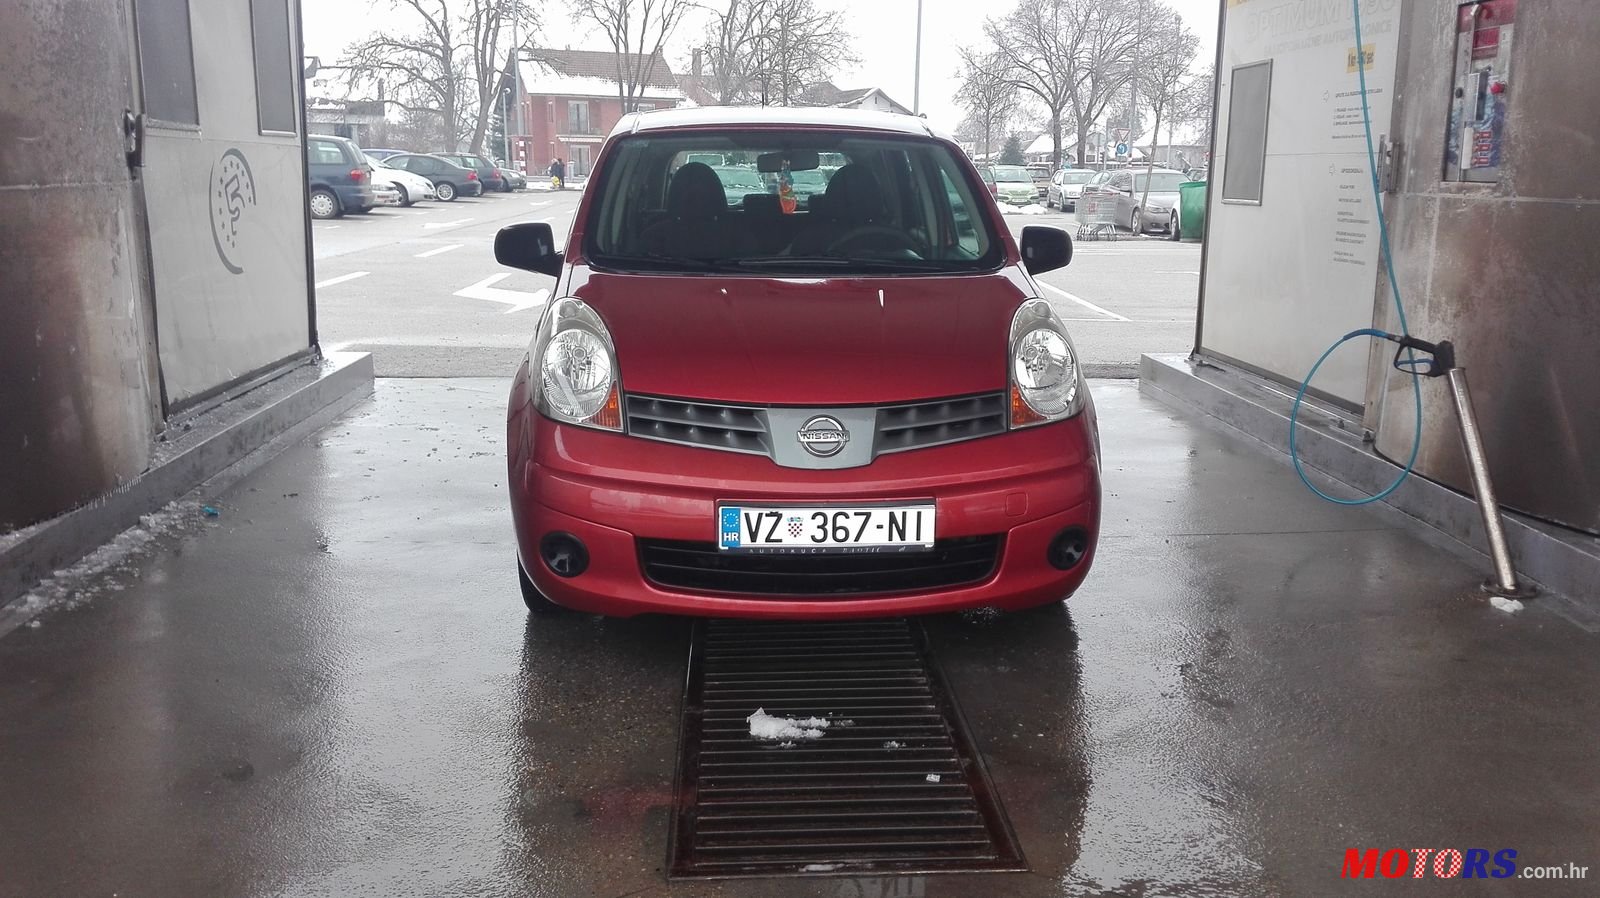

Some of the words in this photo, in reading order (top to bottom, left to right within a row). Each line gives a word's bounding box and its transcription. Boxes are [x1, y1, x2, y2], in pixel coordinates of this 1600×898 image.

[801, 431, 847, 441] NISSAN
[744, 511, 783, 543] VŽ
[811, 511, 922, 543] 367-NI
[723, 532, 739, 542] HR
